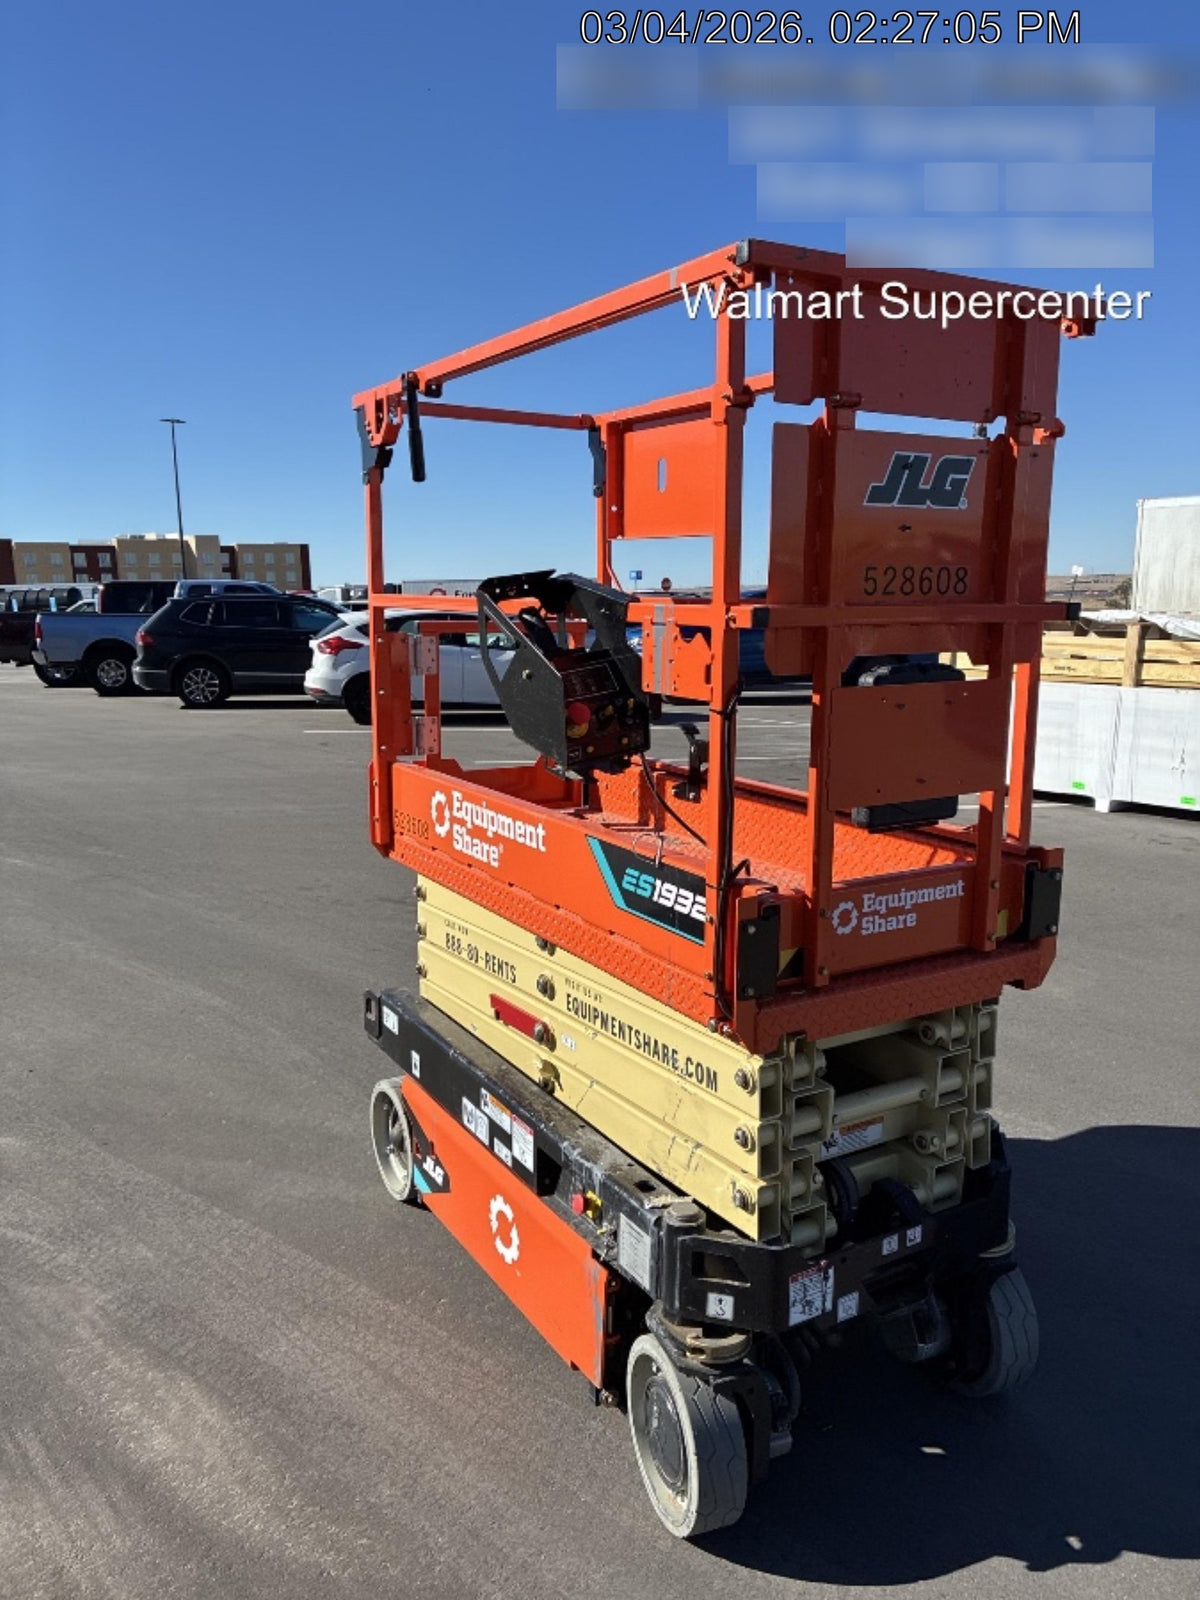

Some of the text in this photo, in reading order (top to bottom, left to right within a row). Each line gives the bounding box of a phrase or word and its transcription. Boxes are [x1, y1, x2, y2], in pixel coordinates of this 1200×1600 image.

[863, 451, 976, 509] JLG
[863, 565, 969, 596] 528608
[451, 789, 547, 852] Equipment
[452, 823, 501, 869] Share
[621, 866, 707, 923] ES1932
[861, 879, 966, 914] Equipment
[861, 912, 918, 936] Share
